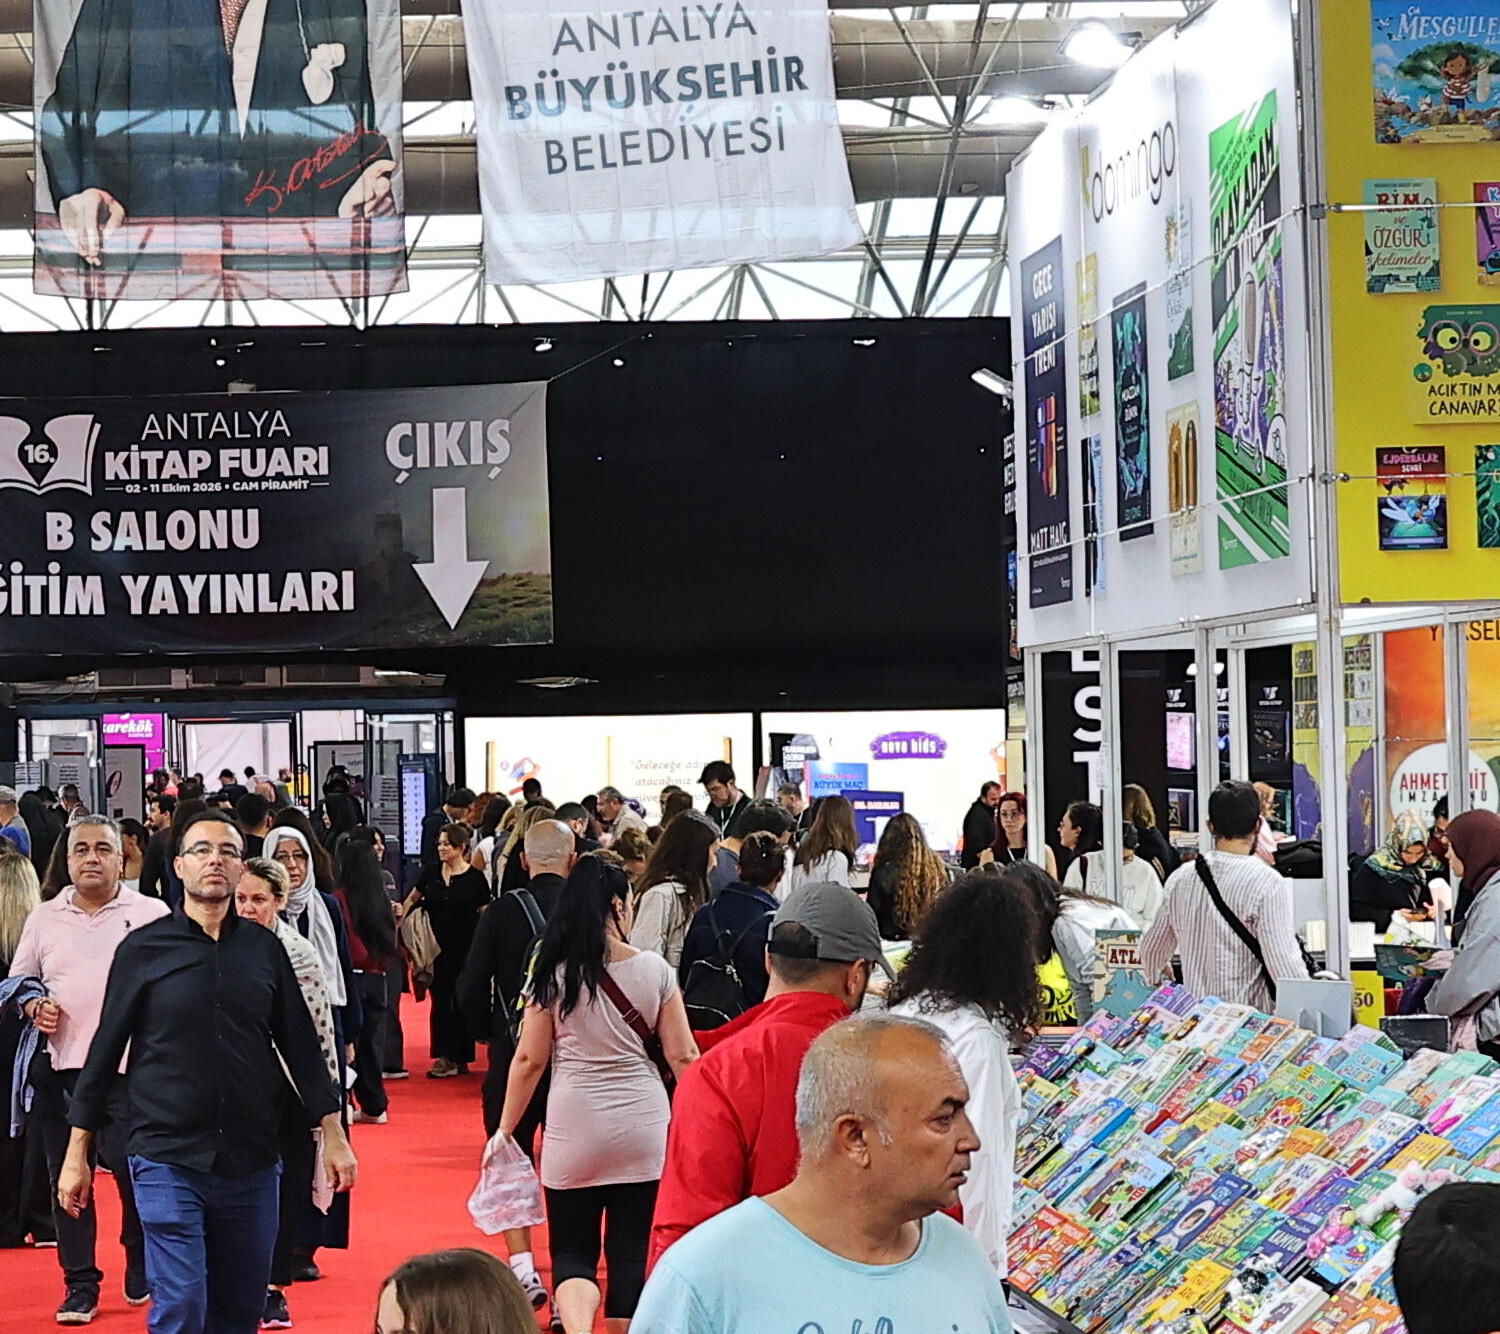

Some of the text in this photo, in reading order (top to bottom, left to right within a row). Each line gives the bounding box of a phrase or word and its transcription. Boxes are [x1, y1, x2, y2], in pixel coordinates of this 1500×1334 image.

[551, 0, 757, 58] ANTALYA
[504, 45, 810, 123] BÜYÜKŞEHİR
[544, 111, 787, 176] BELEDİYESİ
[1091, 119, 1177, 225] domingo
[1373, 225, 1426, 248] ÖZGÜR
[1372, 250, 1431, 267] kelimeler
[1031, 264, 1053, 301] GECE
[1031, 301, 1057, 338] YARISI
[23, 410, 292, 464] 16. ANTALYA
[385, 417, 512, 484] ÇIKIŞ
[103, 442, 330, 482] KİTAP FUARI
[125, 478, 310, 493] 02 11 Ekim 2026 CAM PİRAMİT
[45, 508, 261, 552] B SALONU
[1030, 521, 1068, 552] MATT HAIG
[122, 570, 356, 615] YAYINLARI
[880, 737, 937, 755] nova kids
[1399, 772, 1448, 790] AHMET
